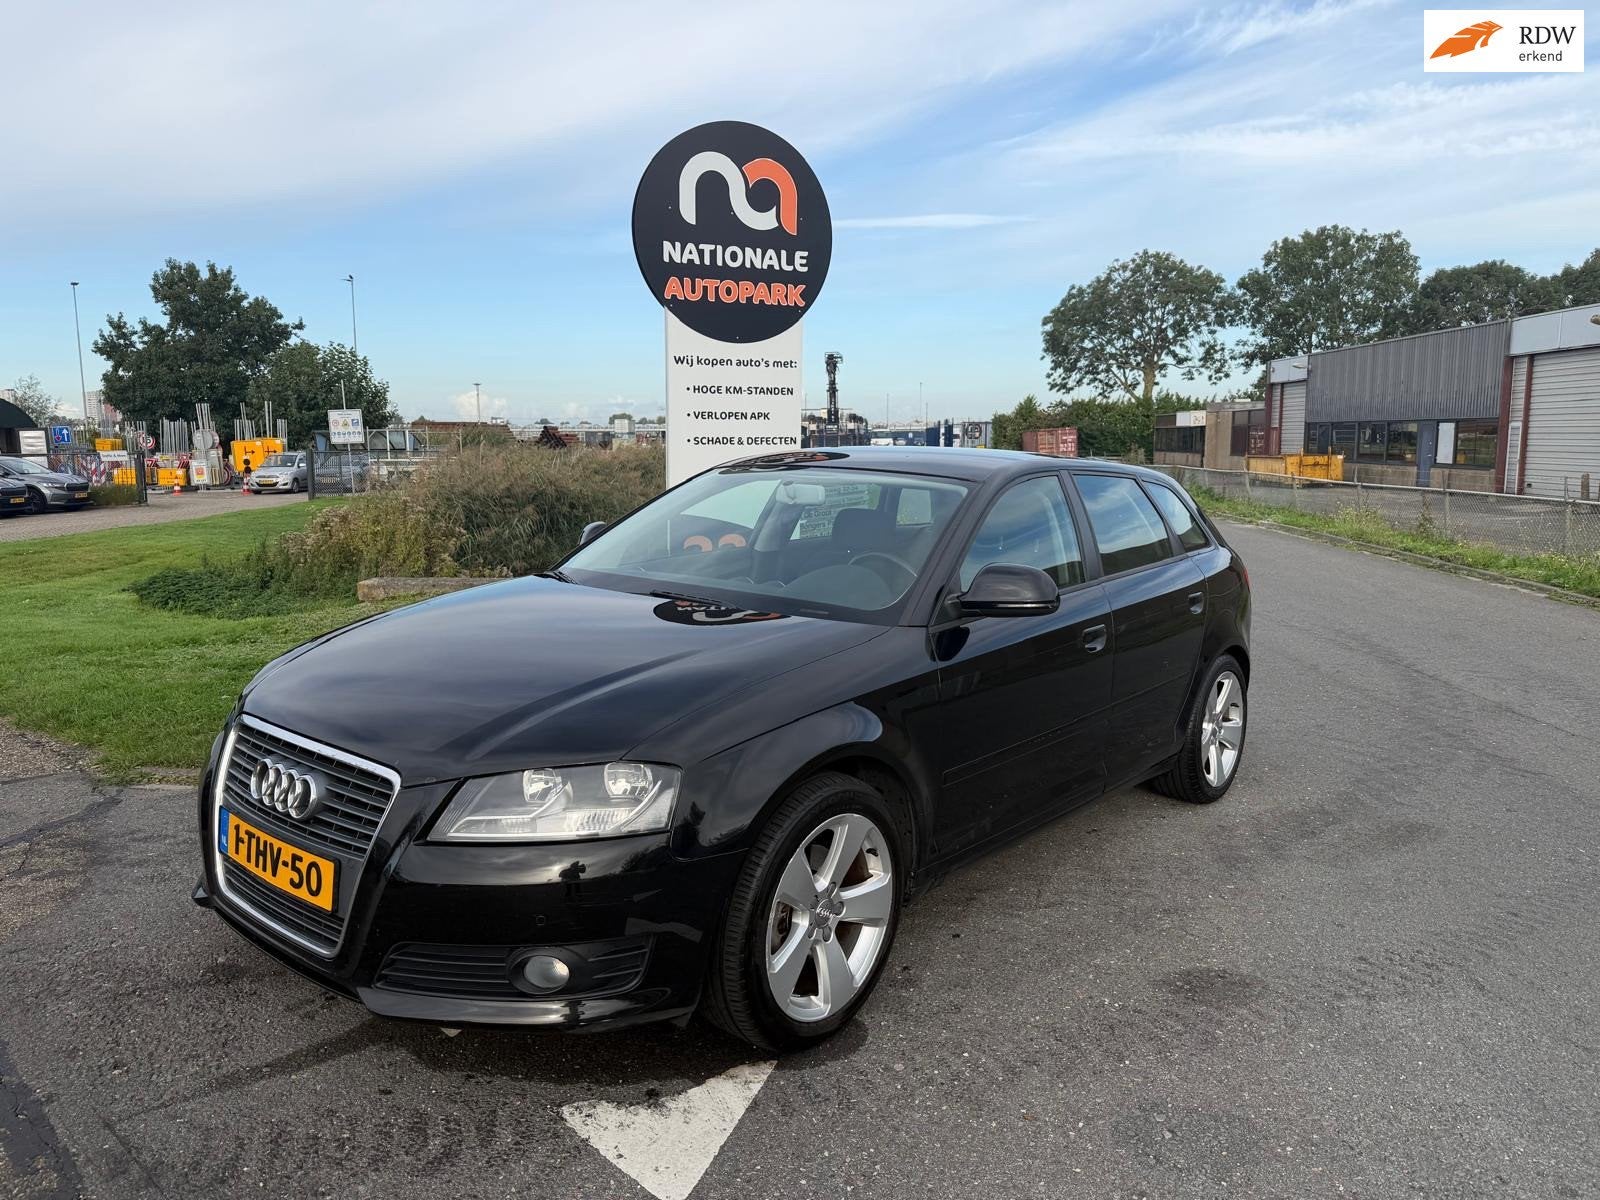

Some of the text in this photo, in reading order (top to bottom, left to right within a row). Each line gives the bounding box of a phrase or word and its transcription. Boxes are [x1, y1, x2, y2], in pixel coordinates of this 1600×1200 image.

[663, 240, 808, 272] NATIONALE
[664, 276, 806, 307] AUTOPARK
[673, 355, 798, 368] Wij kopen auto's met:
[693, 385, 794, 395] HOGE KM-STANDEN
[693, 411, 770, 420] VERLOPEN APK
[693, 436, 797, 445] SCHADE & DEFECTEN
[234, 823, 322, 897] 1-THV-50
